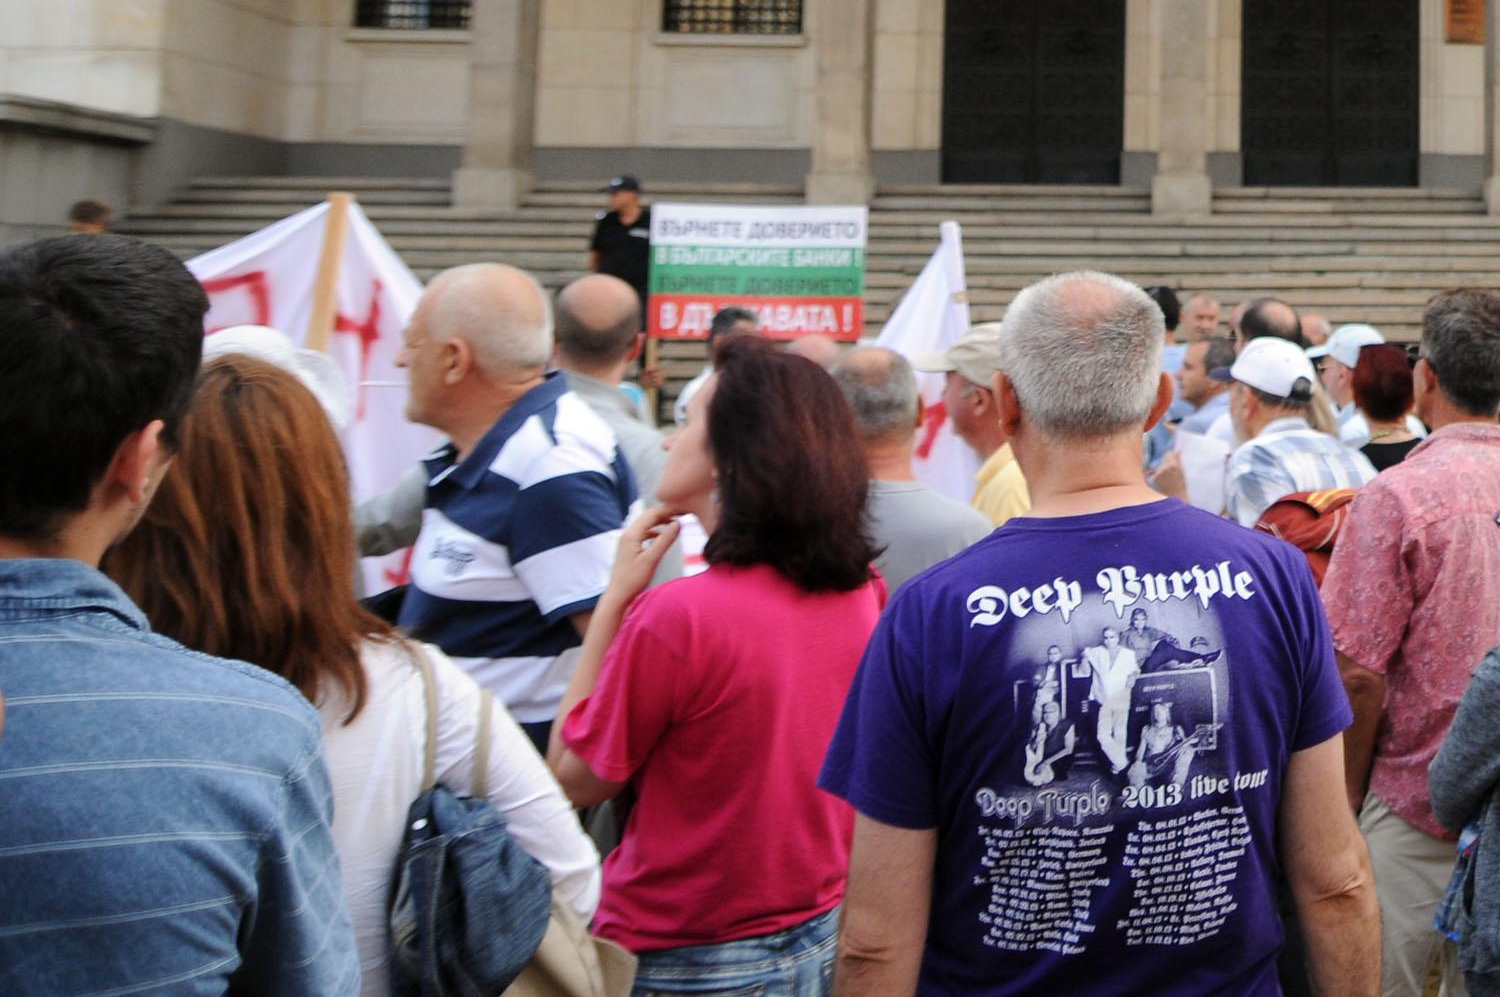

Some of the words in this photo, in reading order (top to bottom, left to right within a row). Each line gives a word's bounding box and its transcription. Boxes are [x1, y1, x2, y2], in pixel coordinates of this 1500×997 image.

[748, 220, 859, 241] ДОВЕРИЕТО
[659, 302, 677, 330] В
[966, 577, 1082, 629] Deep
[1096, 560, 1256, 619] Purple
[1121, 784, 1183, 809] 2013
[1190, 774, 1229, 800] live
[1233, 768, 1268, 792] tour
